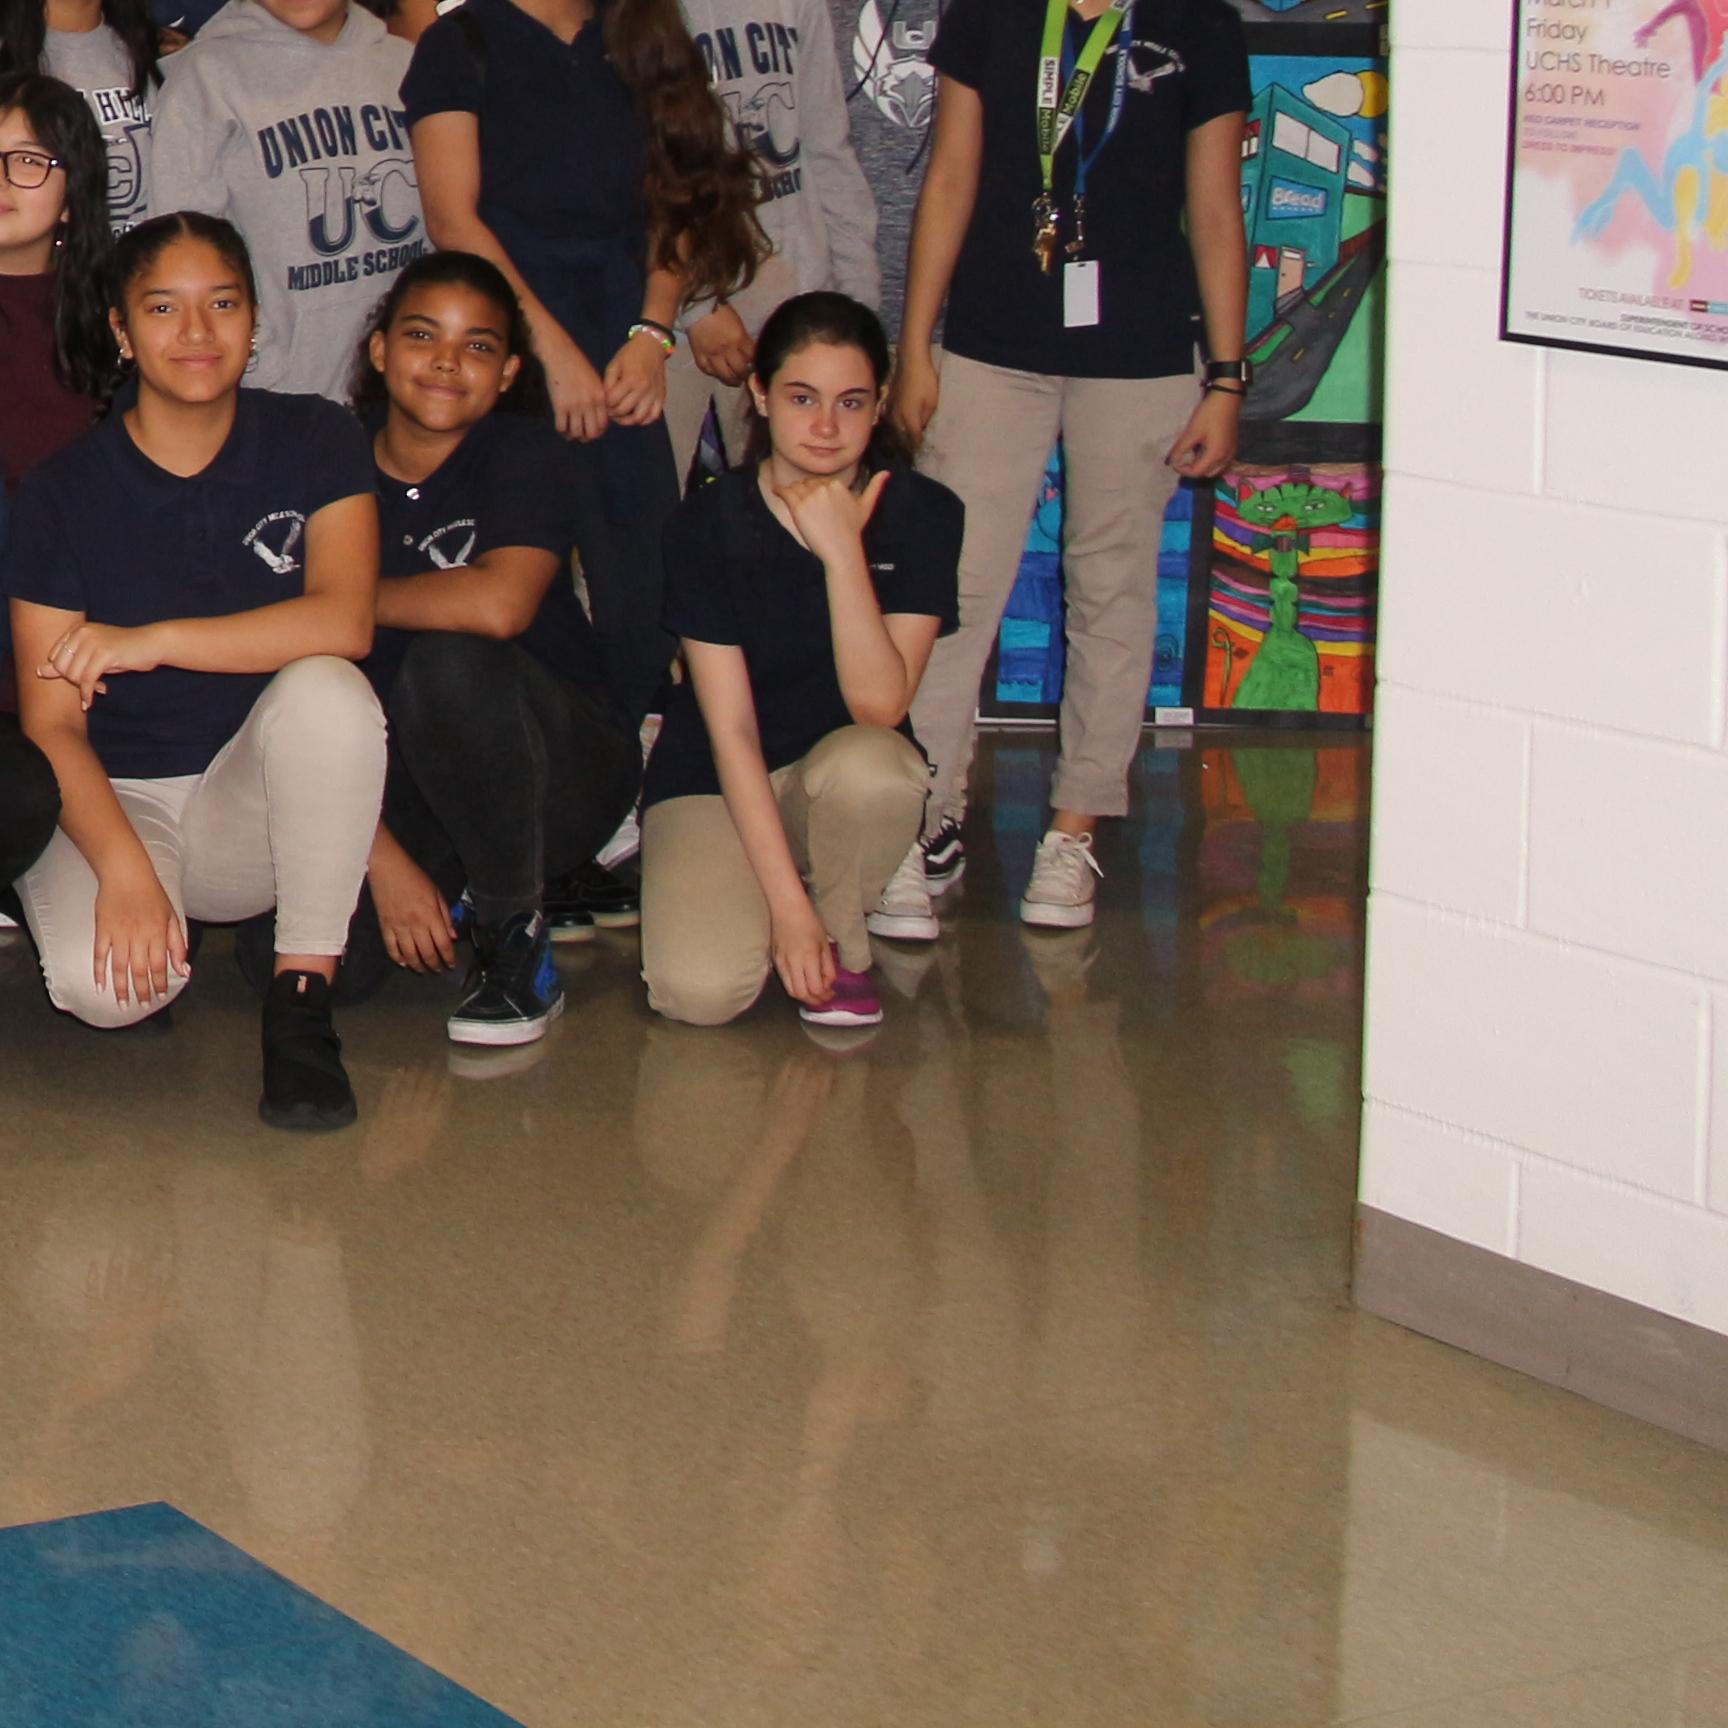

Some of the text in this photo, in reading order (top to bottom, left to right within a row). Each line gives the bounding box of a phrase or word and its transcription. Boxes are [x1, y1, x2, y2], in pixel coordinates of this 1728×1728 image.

[1526, 18, 1588, 45] Friday
[1526, 50, 1672, 79] UCHS Theatre
[1041, 58, 1057, 153] SIMPLE Mobile
[1063, 73, 1090, 115] Mobile
[1525, 83, 1606, 107] 6:00 PM
[257, 104, 358, 179] UNION
[299, 158, 420, 257] UC
[288, 256, 359, 291] MIDDLE
[1569, 315, 1587, 326] CITY
